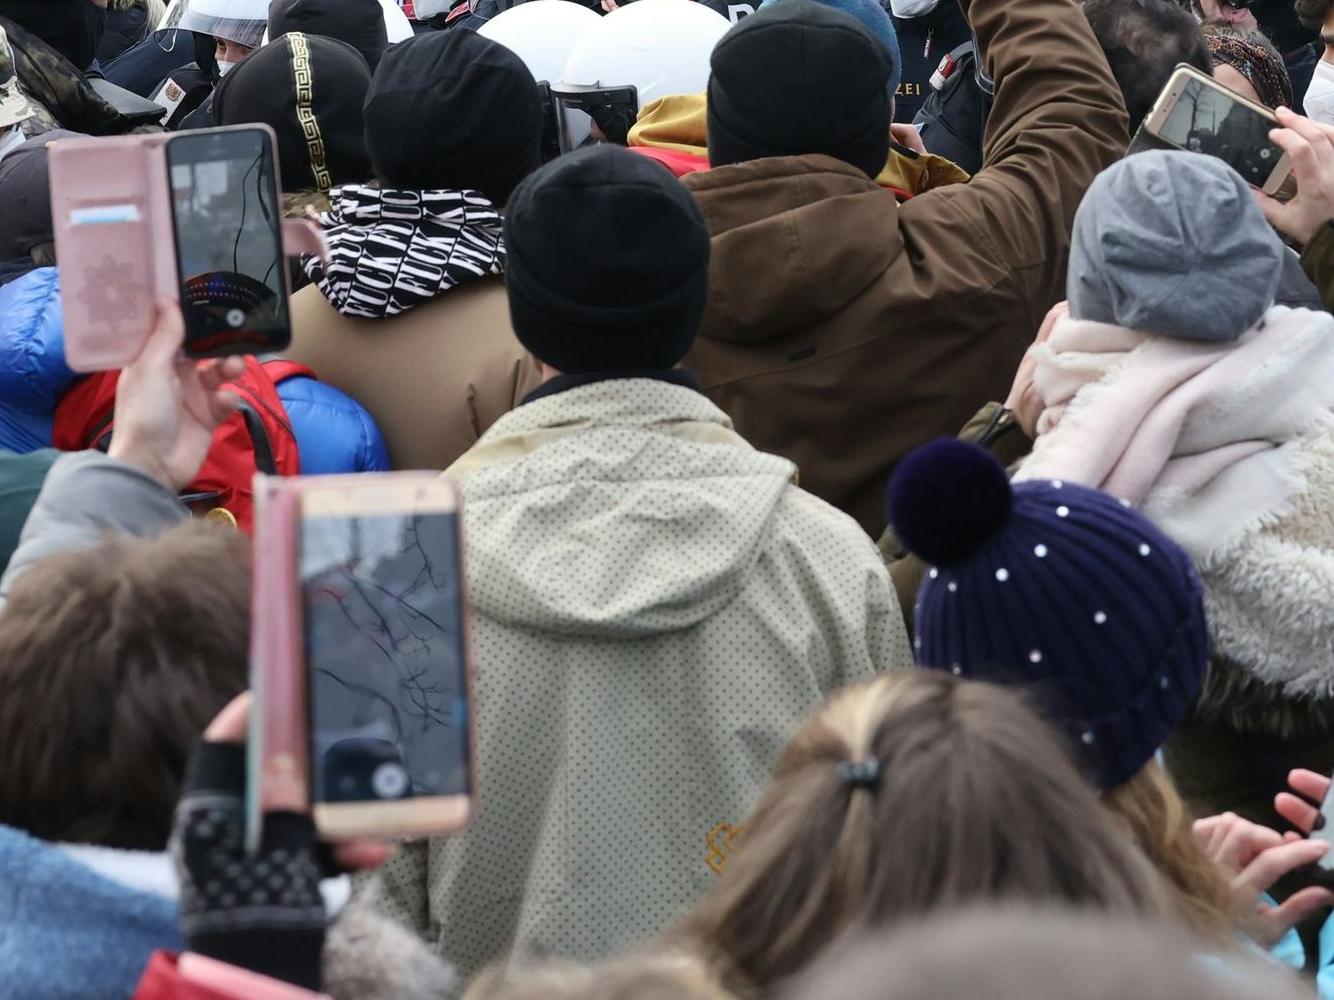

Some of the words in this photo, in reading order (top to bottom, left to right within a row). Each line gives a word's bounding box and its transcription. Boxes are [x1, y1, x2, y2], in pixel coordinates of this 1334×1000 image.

[895, 83, 920, 96] ZEI
[341, 248, 402, 317] FUCK
[394, 226, 456, 294] FUCK
